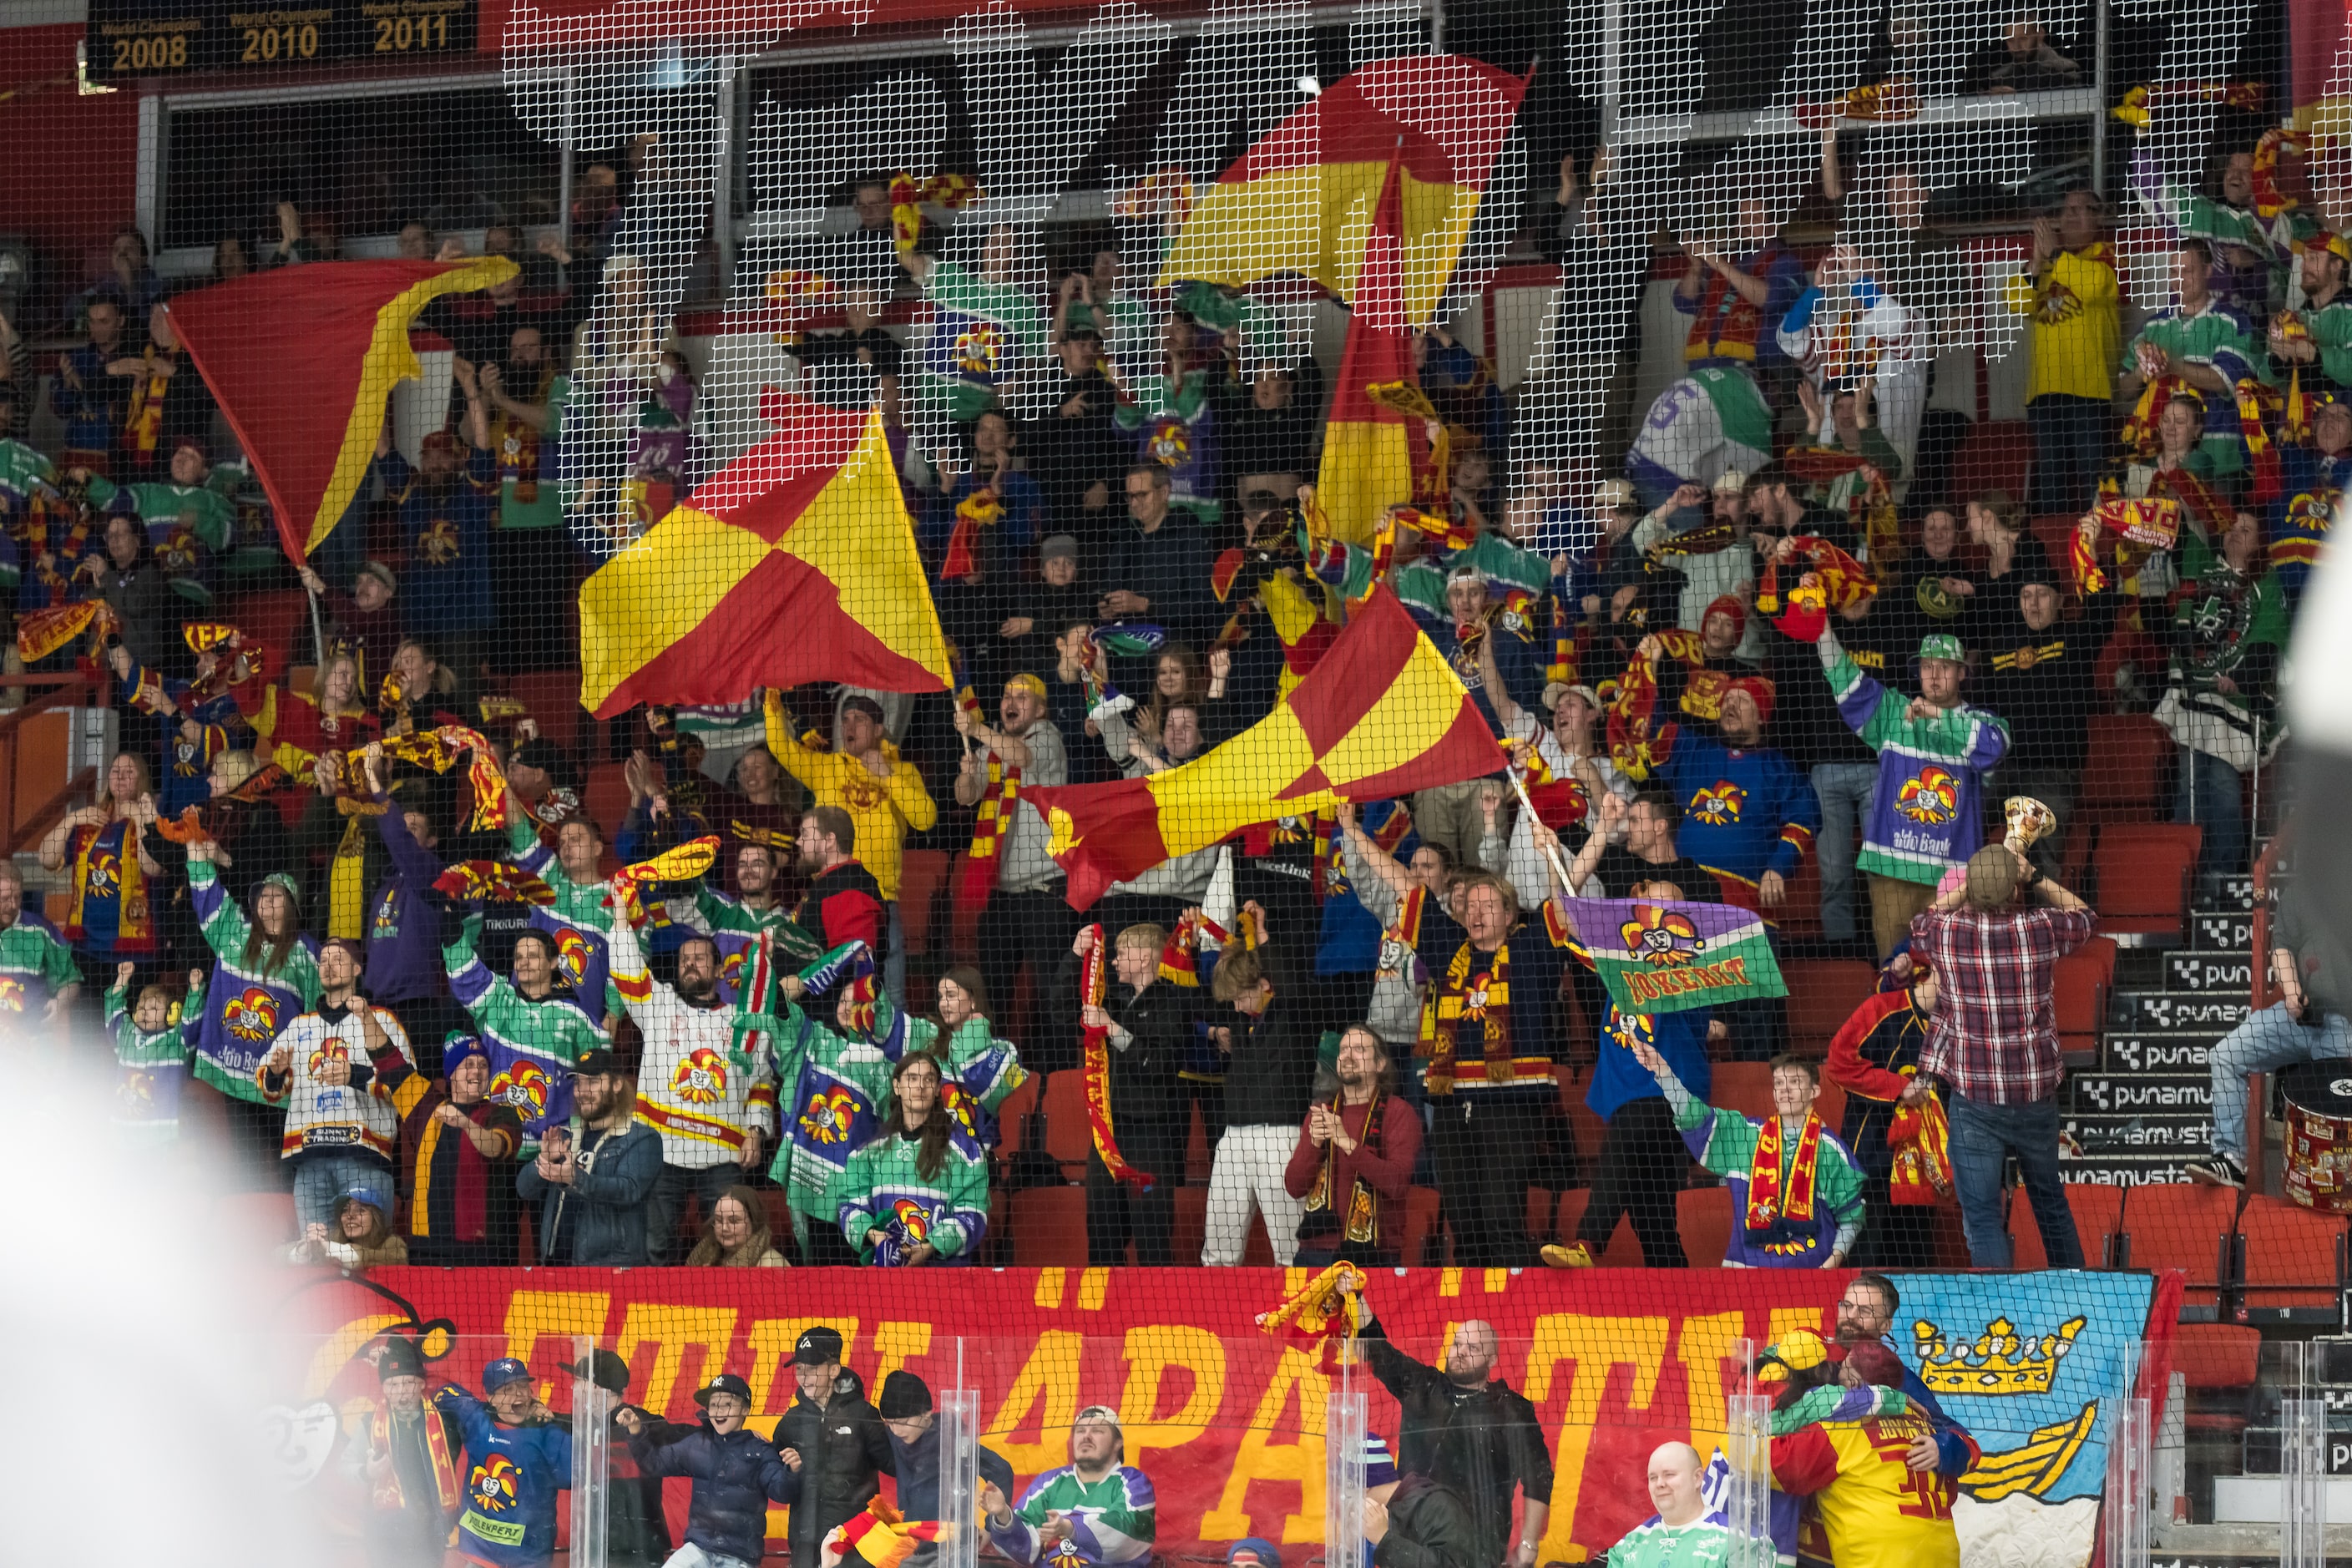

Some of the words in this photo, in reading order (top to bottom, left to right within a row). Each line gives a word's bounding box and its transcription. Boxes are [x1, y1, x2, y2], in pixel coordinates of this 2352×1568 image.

[230, 13, 267, 28] World
[270, 8, 333, 26] Champion
[362, 3, 398, 17] World
[401, 0, 466, 13] Champion
[101, 23, 137, 37] World
[138, 18, 201, 35] Champion
[374, 14, 448, 52] 2011
[113, 35, 188, 71] 2008
[241, 25, 318, 62] 2010
[1920, 833, 1951, 857] Bank
[486, 918, 529, 930] TIKKURI
[1621, 956, 1753, 1005] JOKERIT
[2115, 1086, 2213, 1110] punamu
[2083, 1120, 2213, 1150] punamust
